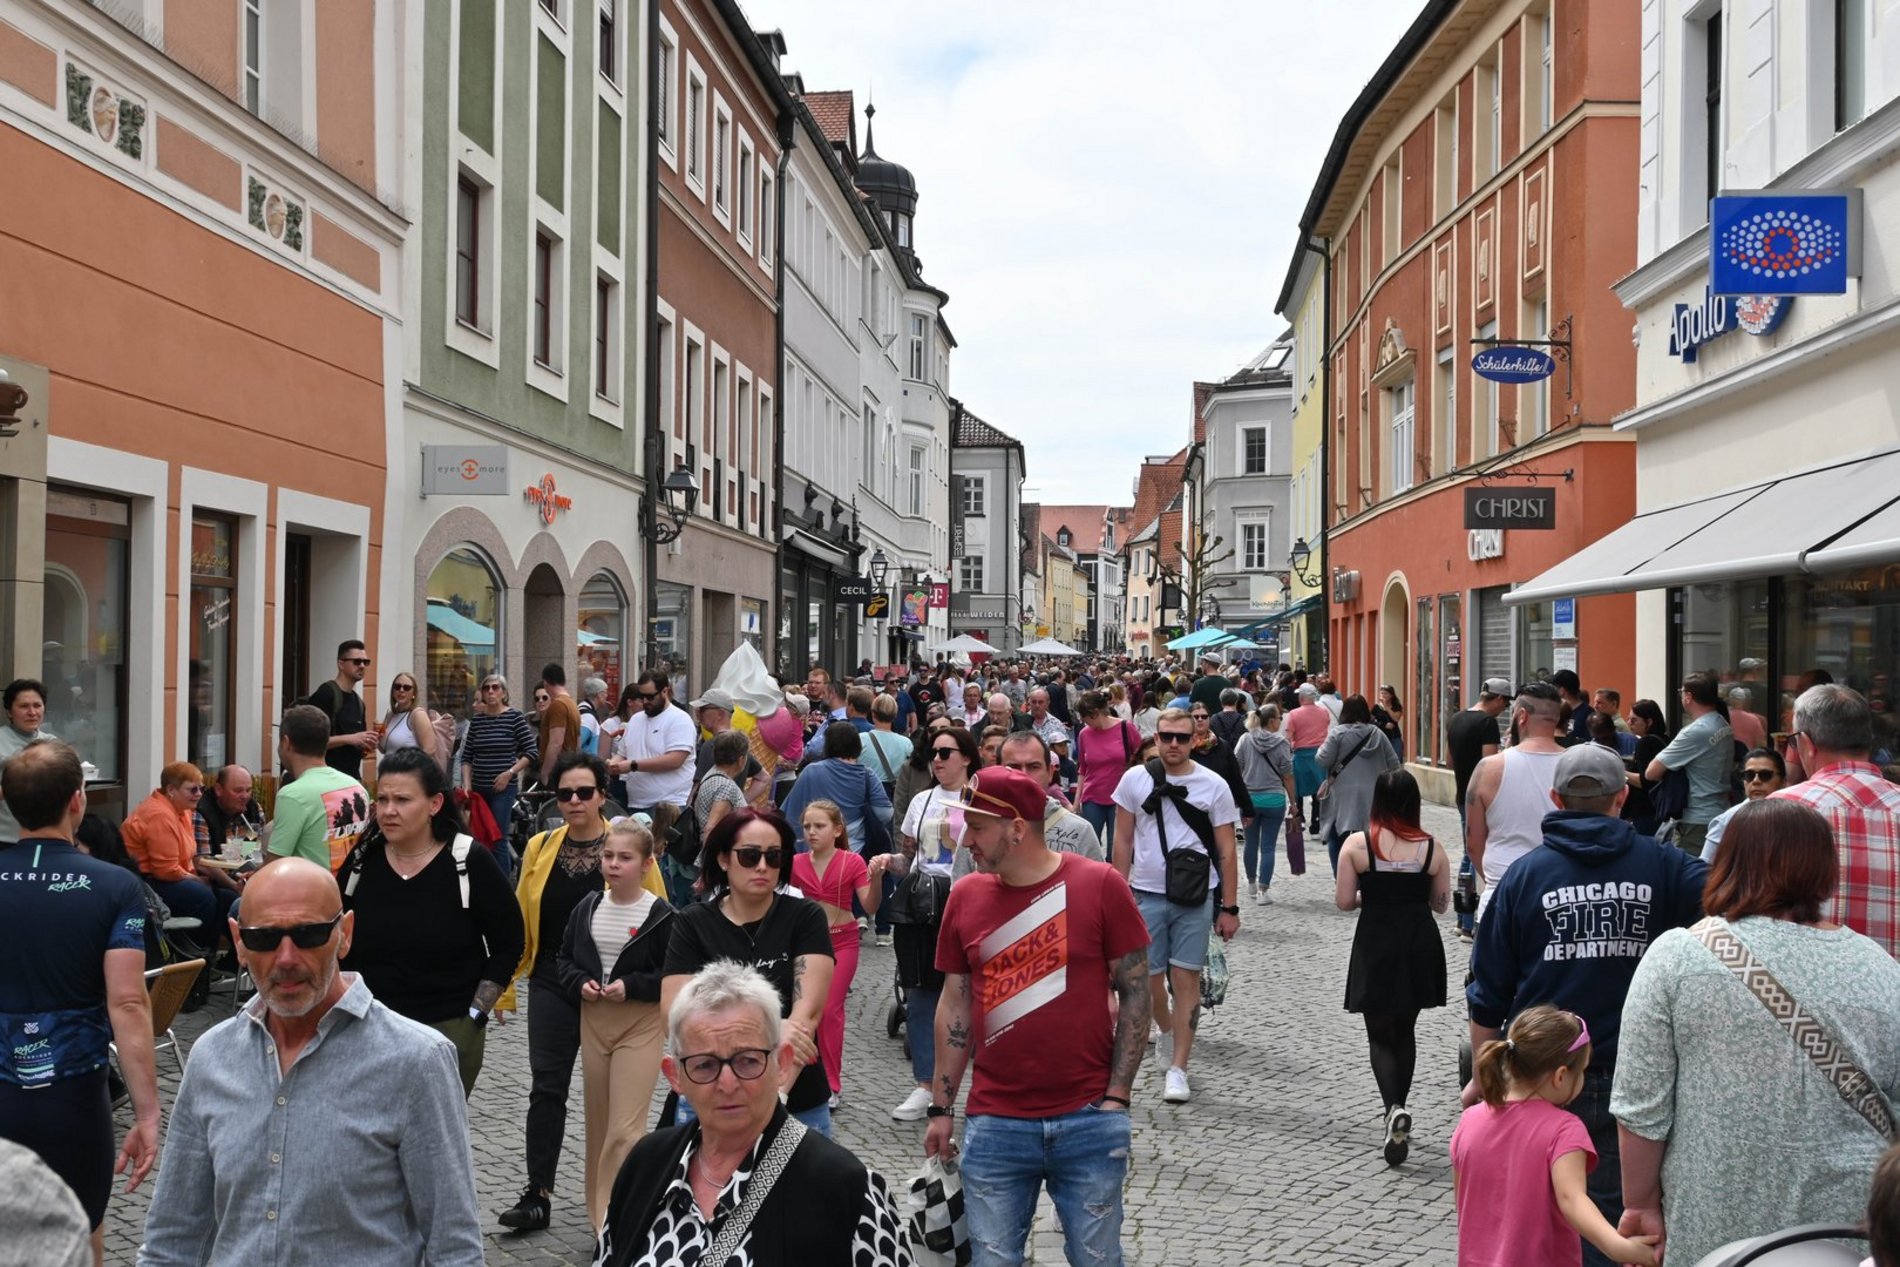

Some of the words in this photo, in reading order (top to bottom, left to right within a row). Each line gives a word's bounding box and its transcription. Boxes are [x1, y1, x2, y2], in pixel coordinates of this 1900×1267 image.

[1669, 285, 1726, 363] Apollo
[437, 465, 461, 475] eyes
[479, 465, 505, 474] more
[1475, 498, 1547, 518] CHRIST
[840, 586, 867, 595] CECIL
[47, 879, 92, 893] RACER
[1541, 881, 1653, 910] CHICAGO
[1544, 899, 1651, 944] FIRE
[1543, 940, 1648, 961] DEPARTMENT
[14, 1038, 52, 1056] RACER
